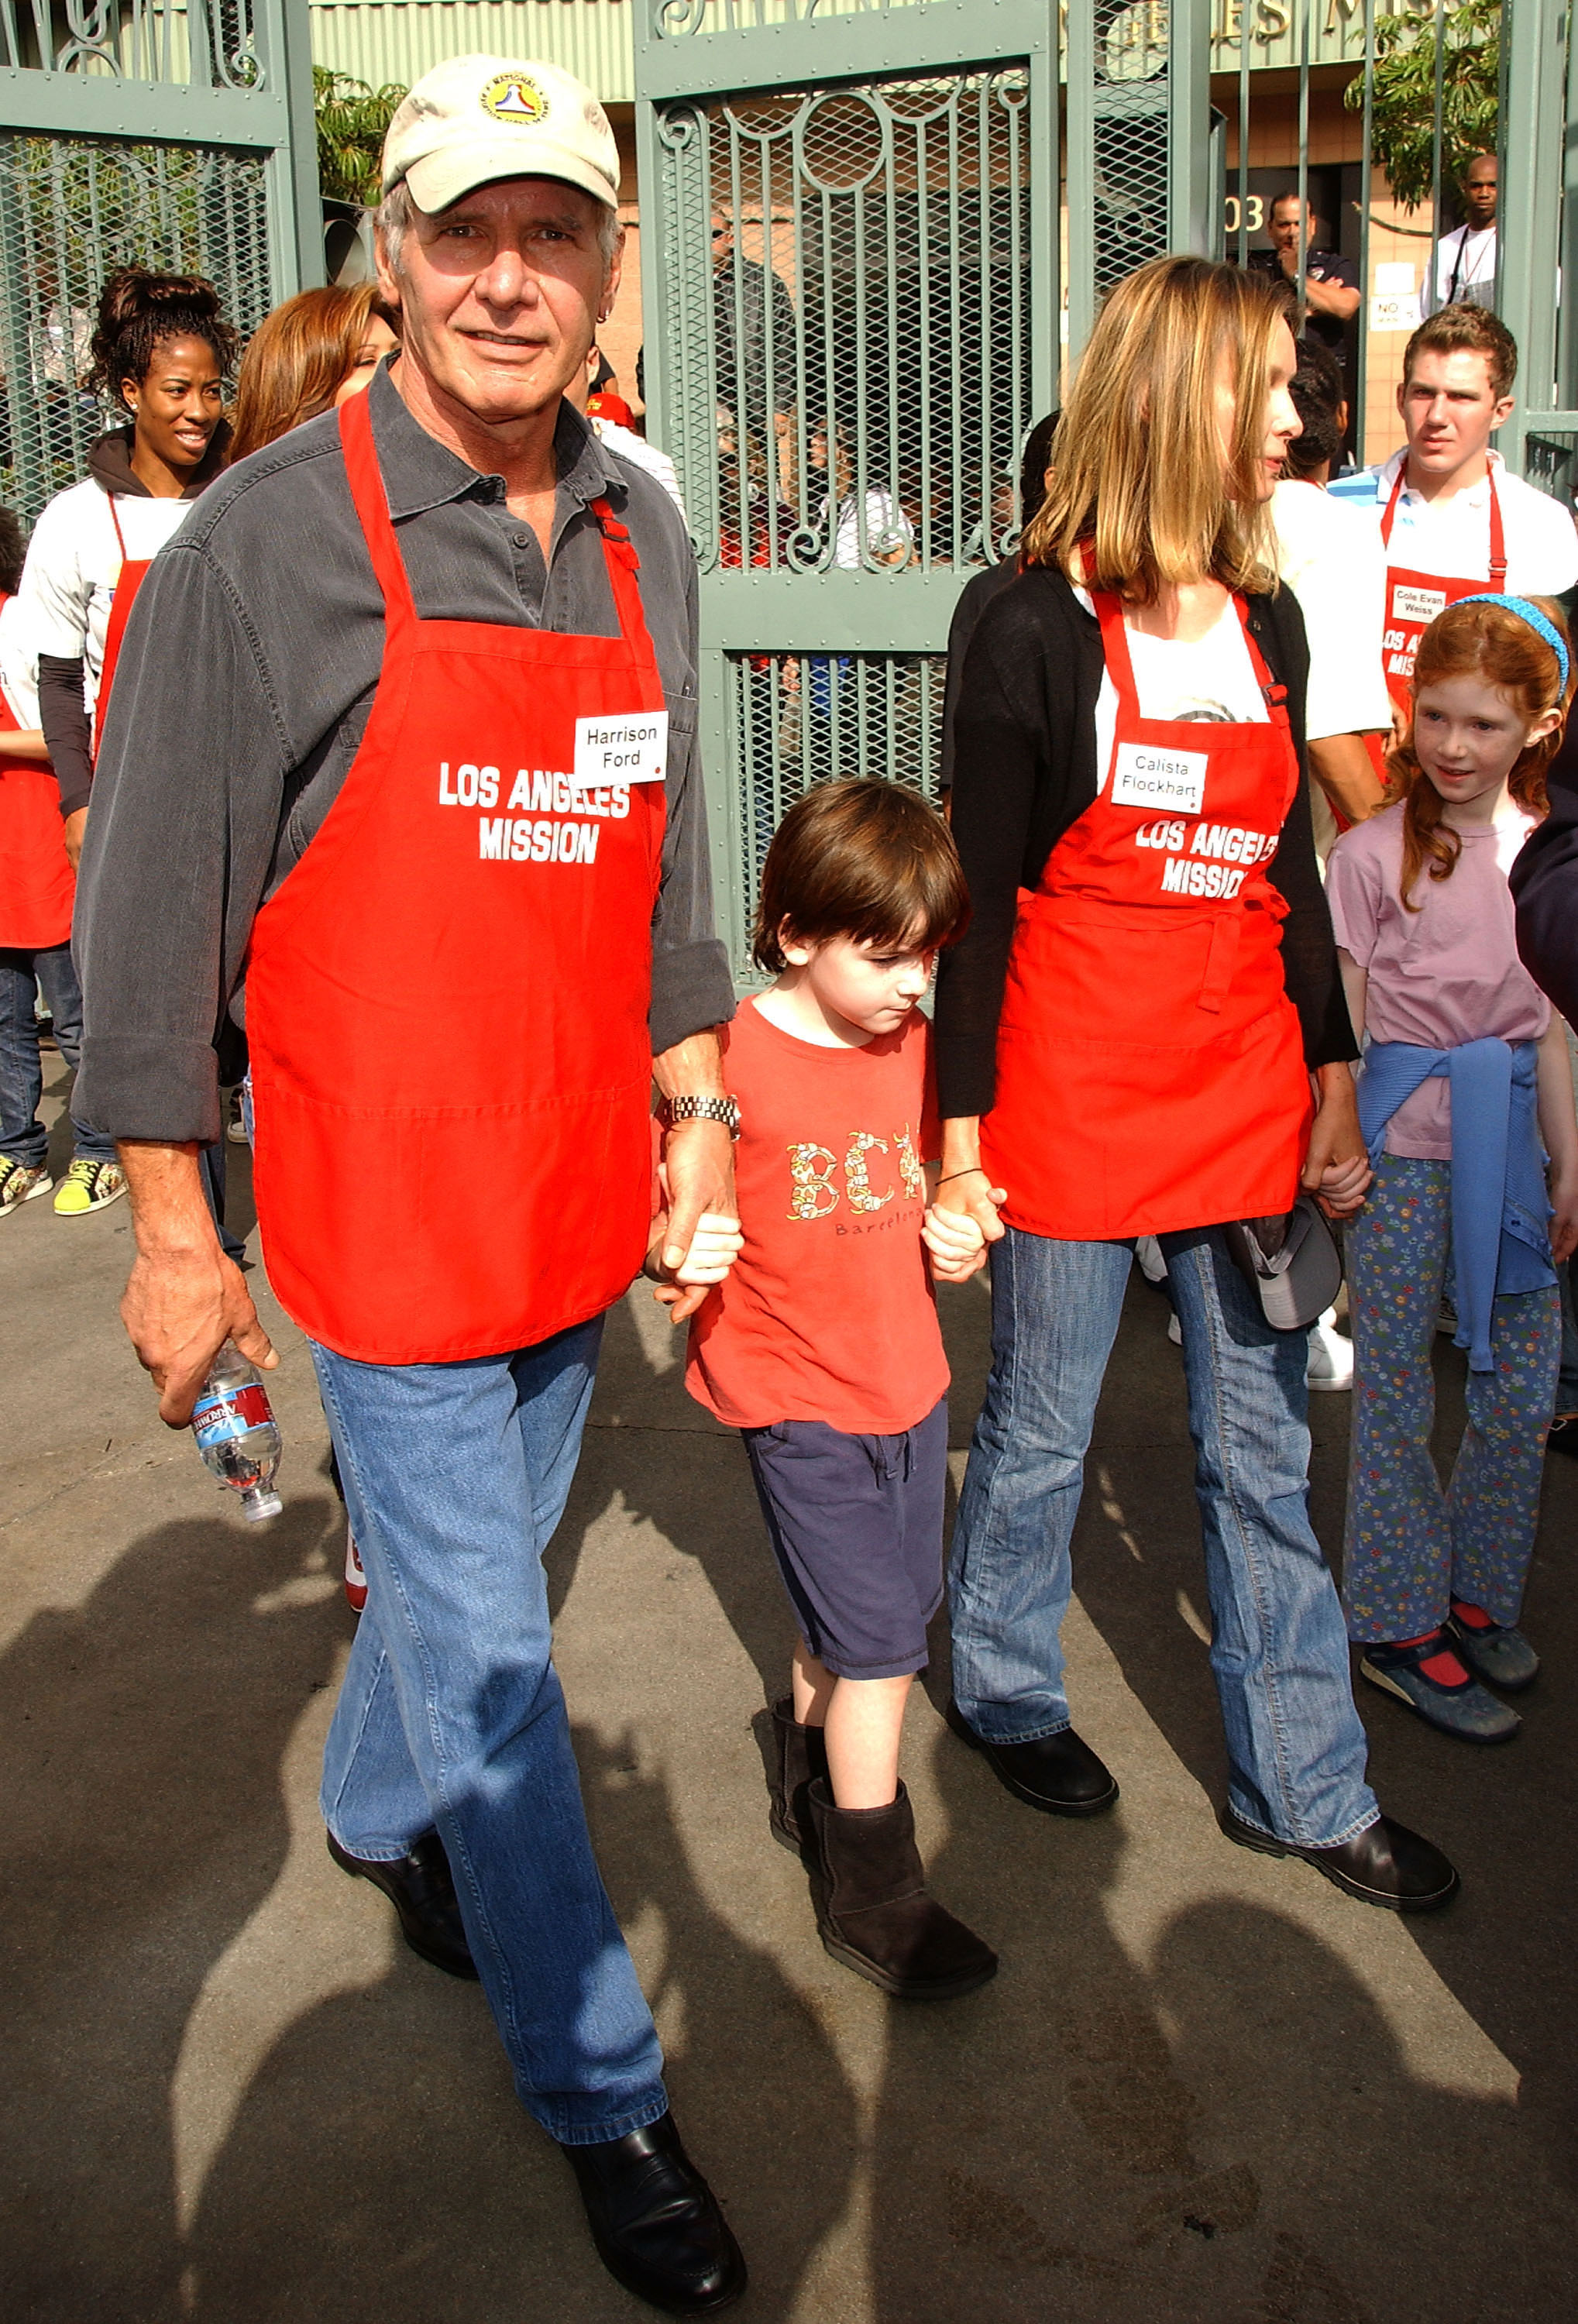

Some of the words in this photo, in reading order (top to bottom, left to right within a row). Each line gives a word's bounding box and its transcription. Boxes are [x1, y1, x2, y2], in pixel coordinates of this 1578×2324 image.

[1397, 590, 1417, 601] Cole
[1420, 594, 1442, 604] Evan
[1405, 603, 1432, 614] Weiss
[1382, 629, 1406, 651] OS
[586, 726, 658, 746] Harrison
[603, 749, 641, 769] Ford
[1135, 755, 1189, 775] Calista
[438, 761, 501, 809] LOS
[507, 769, 630, 819] ANGELES
[1122, 774, 1197, 798] Flockhart
[479, 816, 600, 865] MISSION
[1135, 820, 1187, 851] LOS
[1160, 857, 1249, 900] MISSIO
